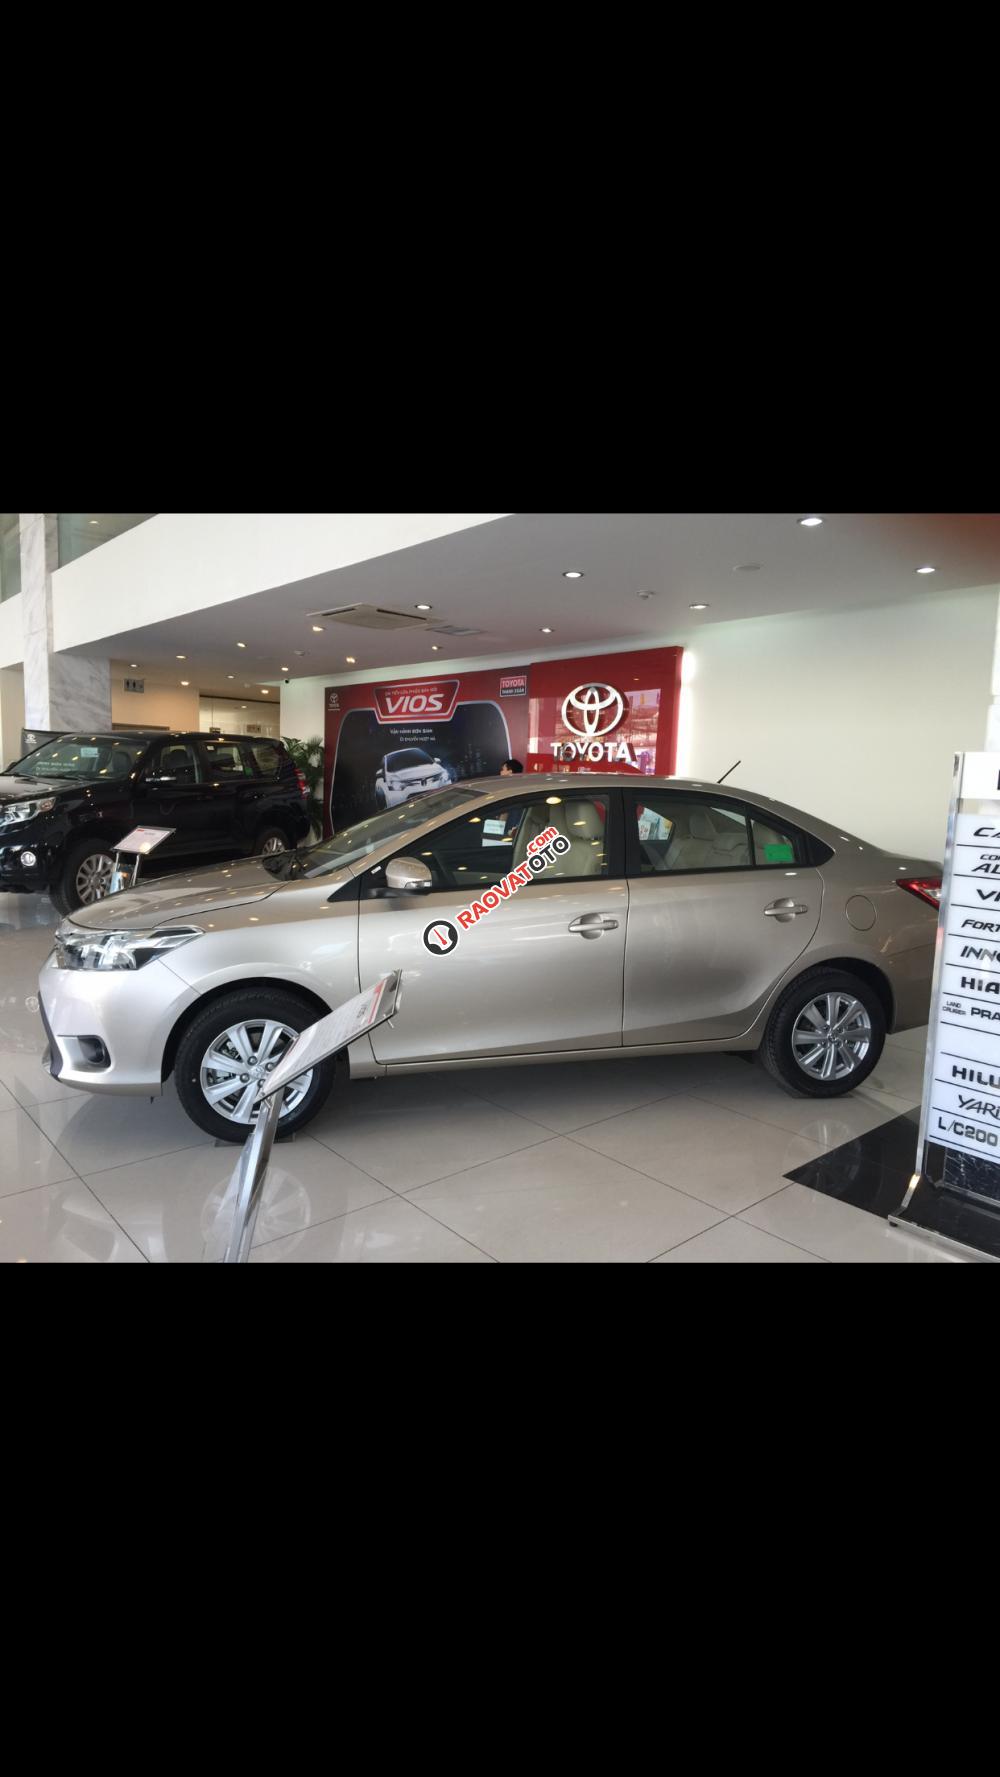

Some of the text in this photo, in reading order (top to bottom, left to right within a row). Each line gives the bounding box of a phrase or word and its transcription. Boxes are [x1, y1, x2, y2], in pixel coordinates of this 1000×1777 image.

[502, 679, 525, 688] TOYOTA
[385, 694, 445, 713] VIOS
[550, 741, 632, 763] TOYOTA
[946, 1000, 962, 1009] LAND
[938, 1116, 998, 1147] L/C200
